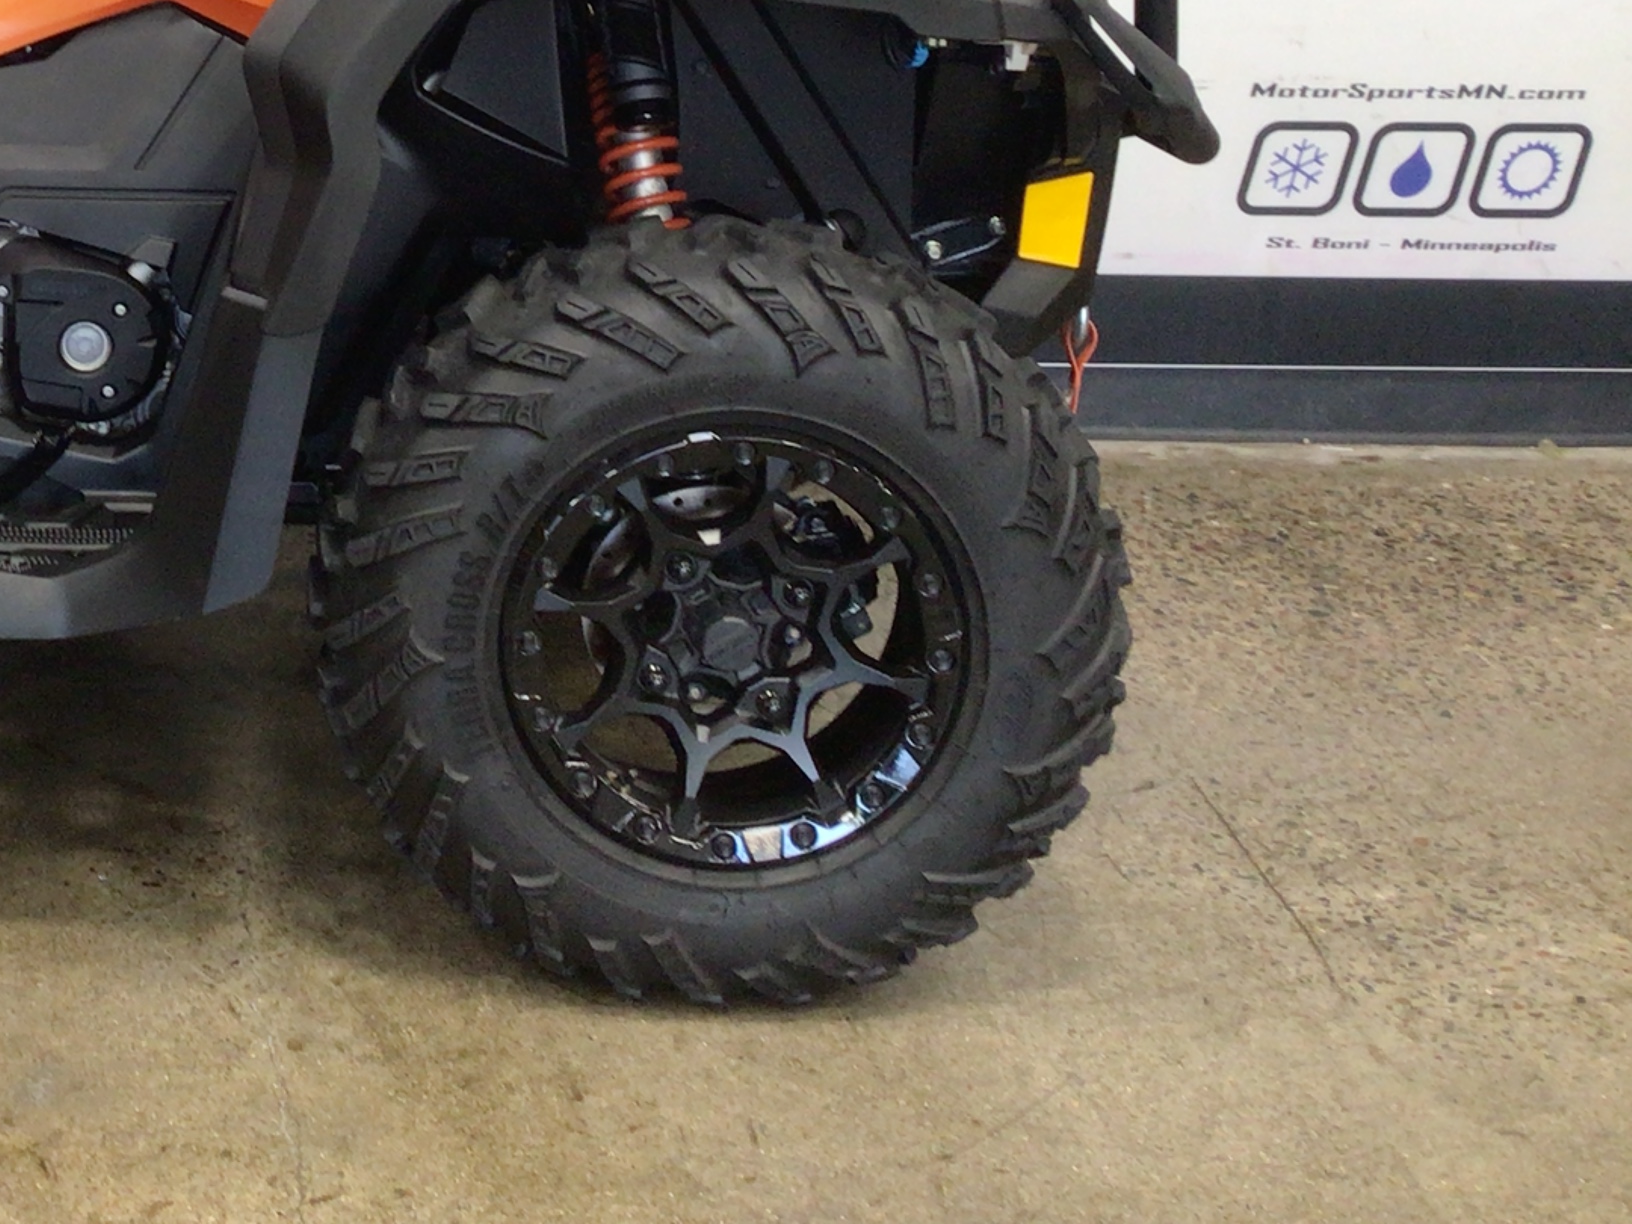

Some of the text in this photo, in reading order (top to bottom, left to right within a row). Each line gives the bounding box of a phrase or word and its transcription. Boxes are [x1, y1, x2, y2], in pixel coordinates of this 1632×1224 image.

[1249, 82, 1587, 103] MotorSportsMN.com
[1265, 236, 1301, 249] St.
[1311, 236, 1371, 250] Boni
[1399, 238, 1558, 254] Minneapolis
